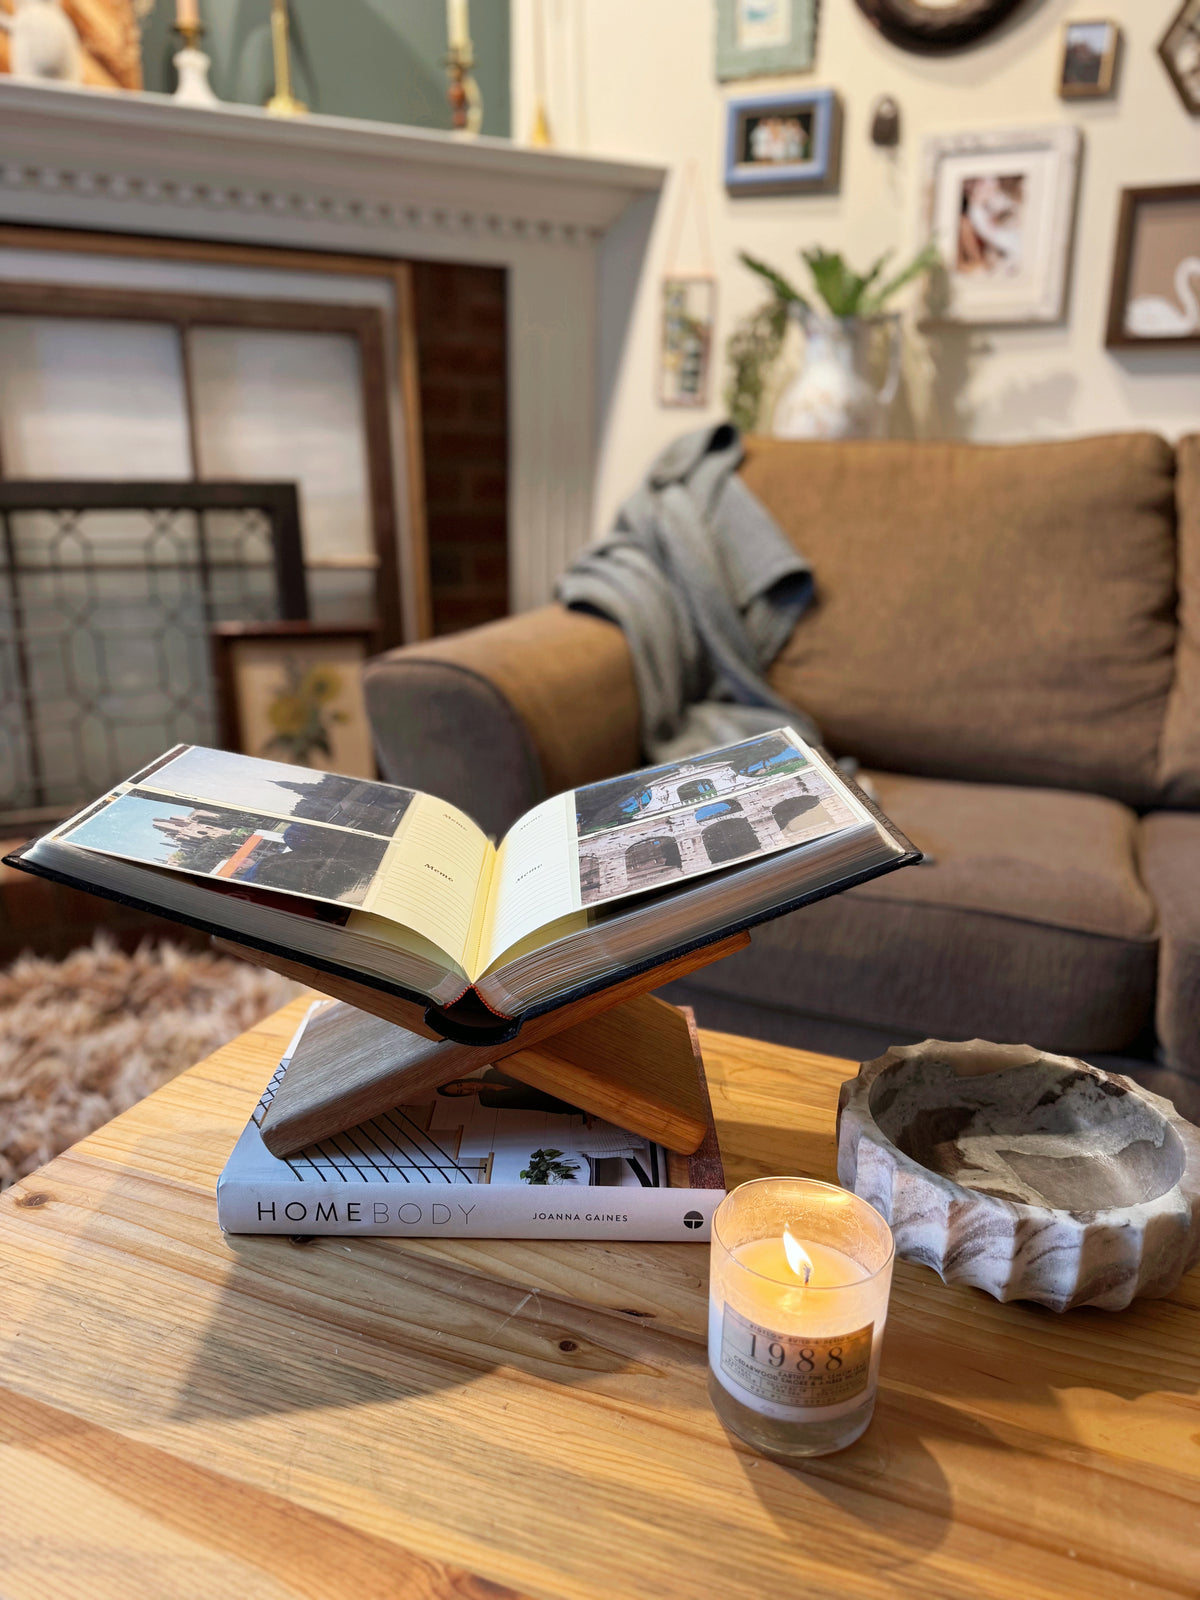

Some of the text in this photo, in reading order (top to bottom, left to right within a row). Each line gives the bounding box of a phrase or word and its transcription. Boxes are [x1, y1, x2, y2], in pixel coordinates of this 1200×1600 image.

[423, 863, 454, 883] Memo
[532, 1212, 629, 1222] JOANNA GAINES
[749, 1333, 844, 1373] 1988
[733, 1354, 778, 1381] CEDARWOOD
